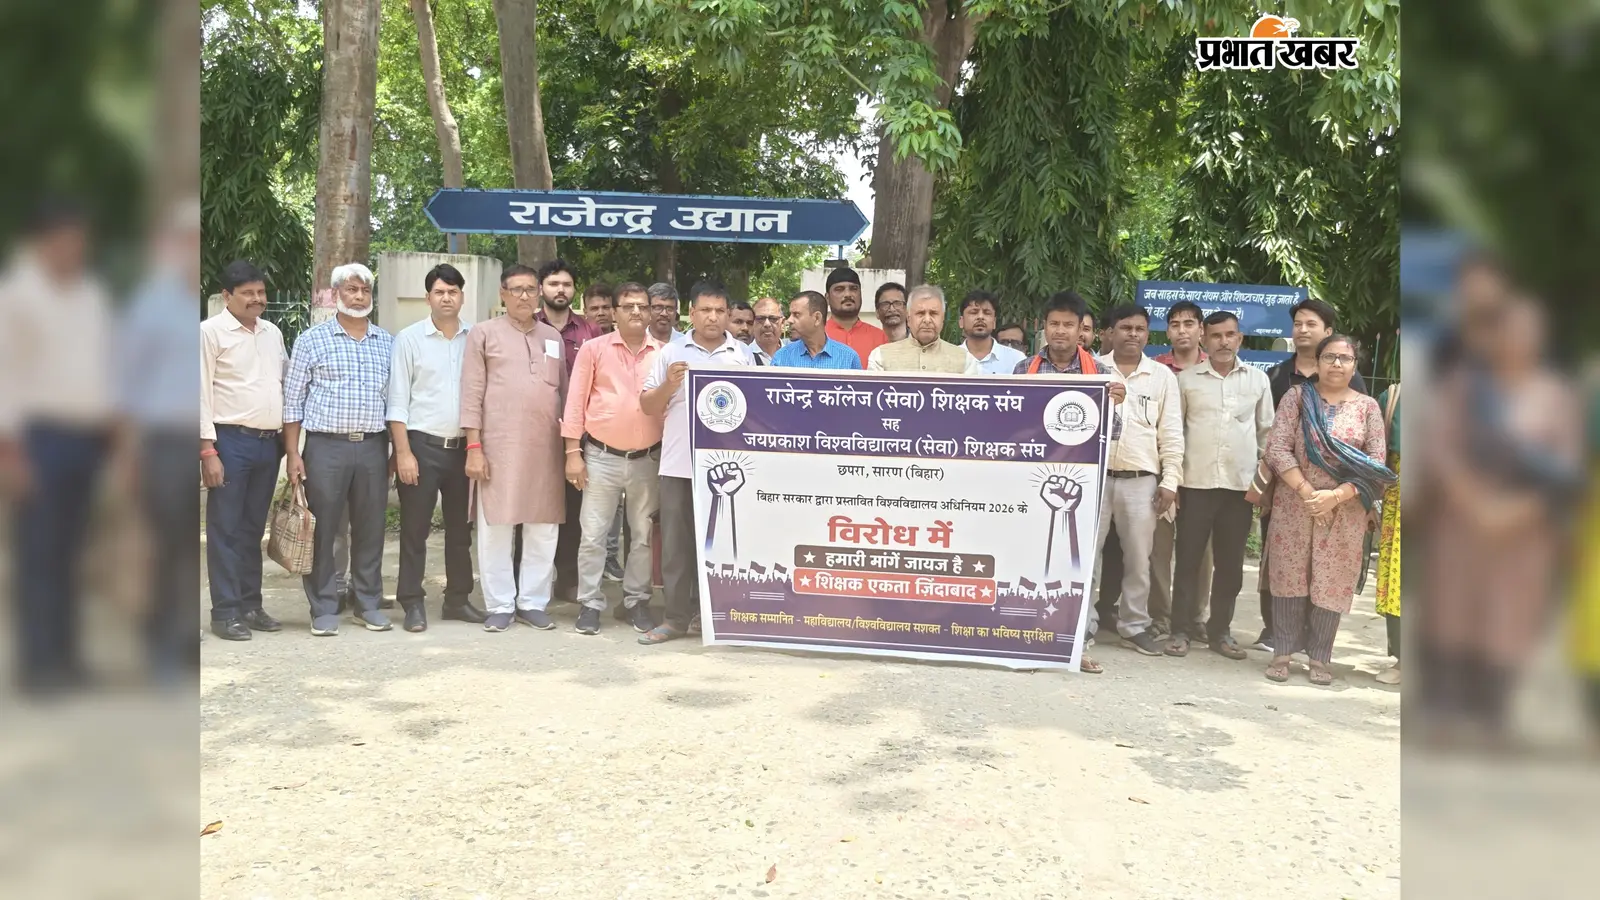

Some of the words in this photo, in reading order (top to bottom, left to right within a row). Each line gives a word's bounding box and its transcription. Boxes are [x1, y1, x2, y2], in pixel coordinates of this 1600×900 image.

[508, 197, 657, 234] राजेन्द्र
[669, 206, 792, 233] उद्यान
[1144, 288, 1157, 300] जब
[1179, 287, 1187, 300] के
[1293, 292, 1300, 305] है
[1154, 307, 1167, 319] वह
[765, 382, 814, 409] राजेन्द्र
[817, 384, 873, 407] कॉलेज
[876, 385, 925, 412] (सेवा)
[931, 387, 990, 414] शिक्षक
[993, 389, 1025, 412] संघ
[881, 418, 901, 432] सह
[743, 432, 811, 450] जयप्रकाश
[814, 430, 912, 453] विश्वविद्यालय
[915, 434, 958, 457] (सेवा)
[963, 436, 1016, 459] शिक्षक
[1019, 438, 1047, 458] संघ
[872, 466, 903, 478] सारण
[905, 464, 944, 481] (बिहार)
[756, 489, 781, 503] बिहार
[782, 493, 813, 504] सरकार
[815, 495, 834, 506] द्वारा
[836, 494, 873, 507] प्रस्तावित
[876, 495, 937, 510] विश्वविद्यालय
[940, 498, 986, 512] अधिनियम
[988, 503, 1014, 514] 2026
[1017, 501, 1028, 514] के
[827, 515, 919, 546] विरोध
[927, 519, 954, 548] में
[825, 550, 866, 568] हमारी
[870, 551, 900, 569] मांगें
[904, 556, 948, 572] जायज
[952, 555, 964, 574] है
[814, 571, 863, 591] शिक्षक
[867, 579, 911, 594] एकता
[915, 577, 977, 599] ज़िंदाबाद
[730, 608, 758, 624] शिक्षक
[759, 611, 794, 625] सम्मानित
[912, 622, 941, 635] सशक्त
[951, 622, 975, 638] शिक्षा
[976, 626, 990, 638] का
[992, 625, 1021, 640] भविष्य
[1022, 627, 1054, 644] सुरक्षित
